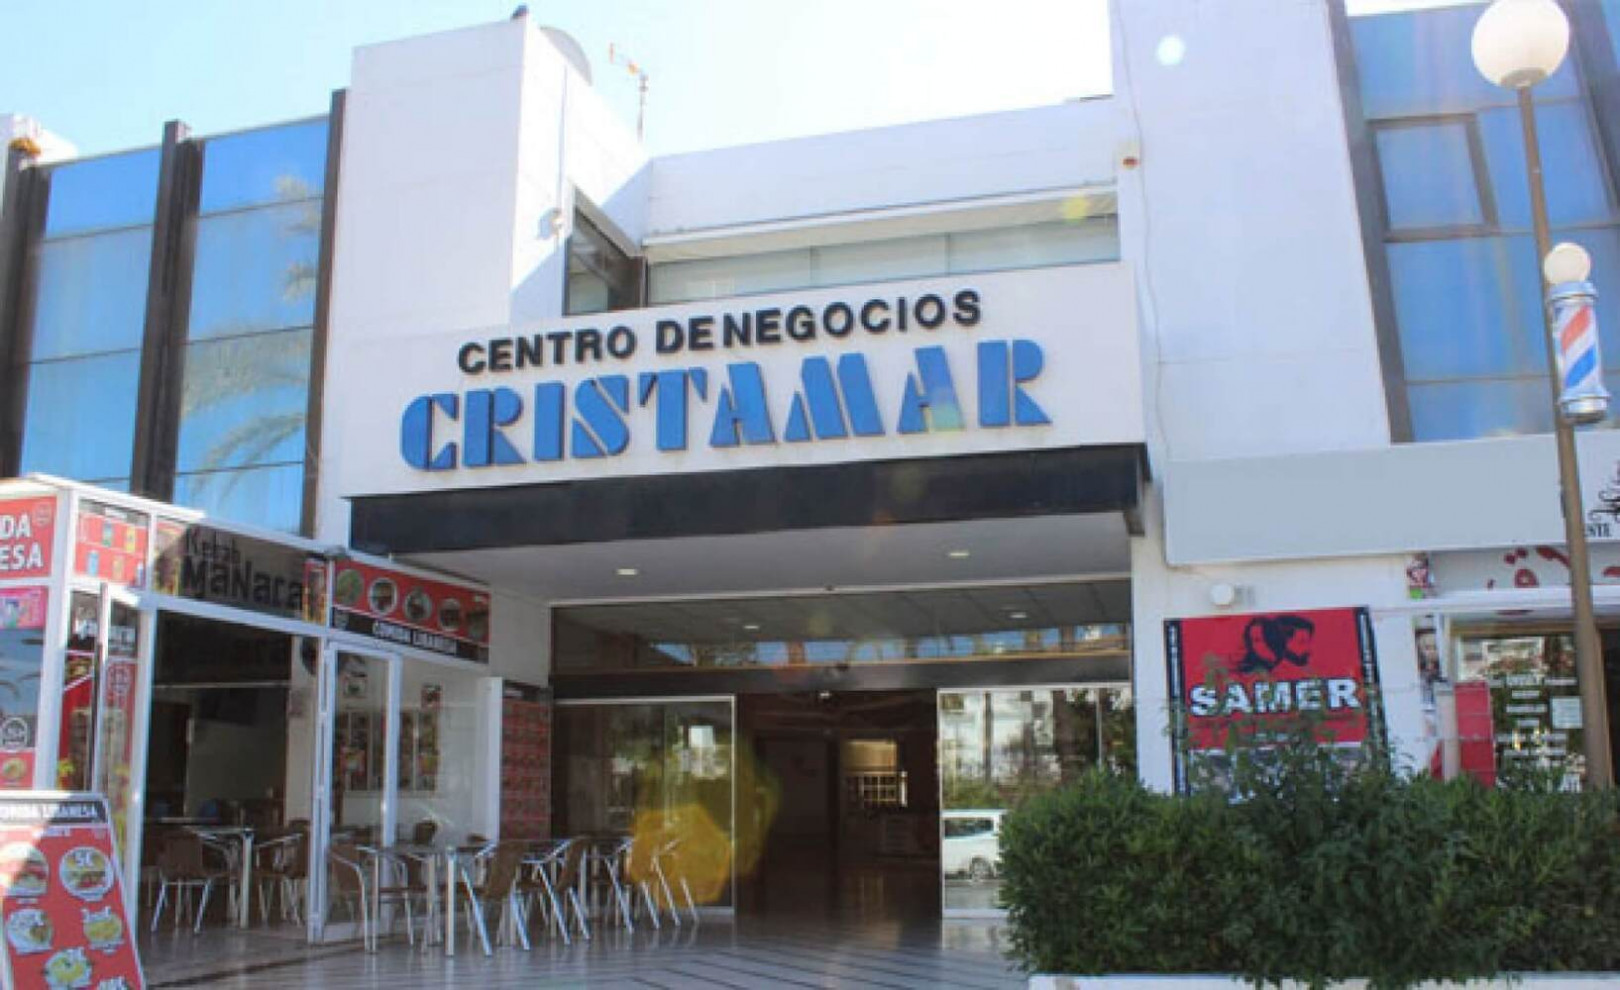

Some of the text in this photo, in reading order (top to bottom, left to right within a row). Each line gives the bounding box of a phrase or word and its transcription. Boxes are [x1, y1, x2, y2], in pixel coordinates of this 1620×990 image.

[457, 288, 981, 374] CENTRO DE NEGOCIOS
[399, 338, 1054, 472] CRISTAMAR
[1189, 678, 1362, 717] SAMER
